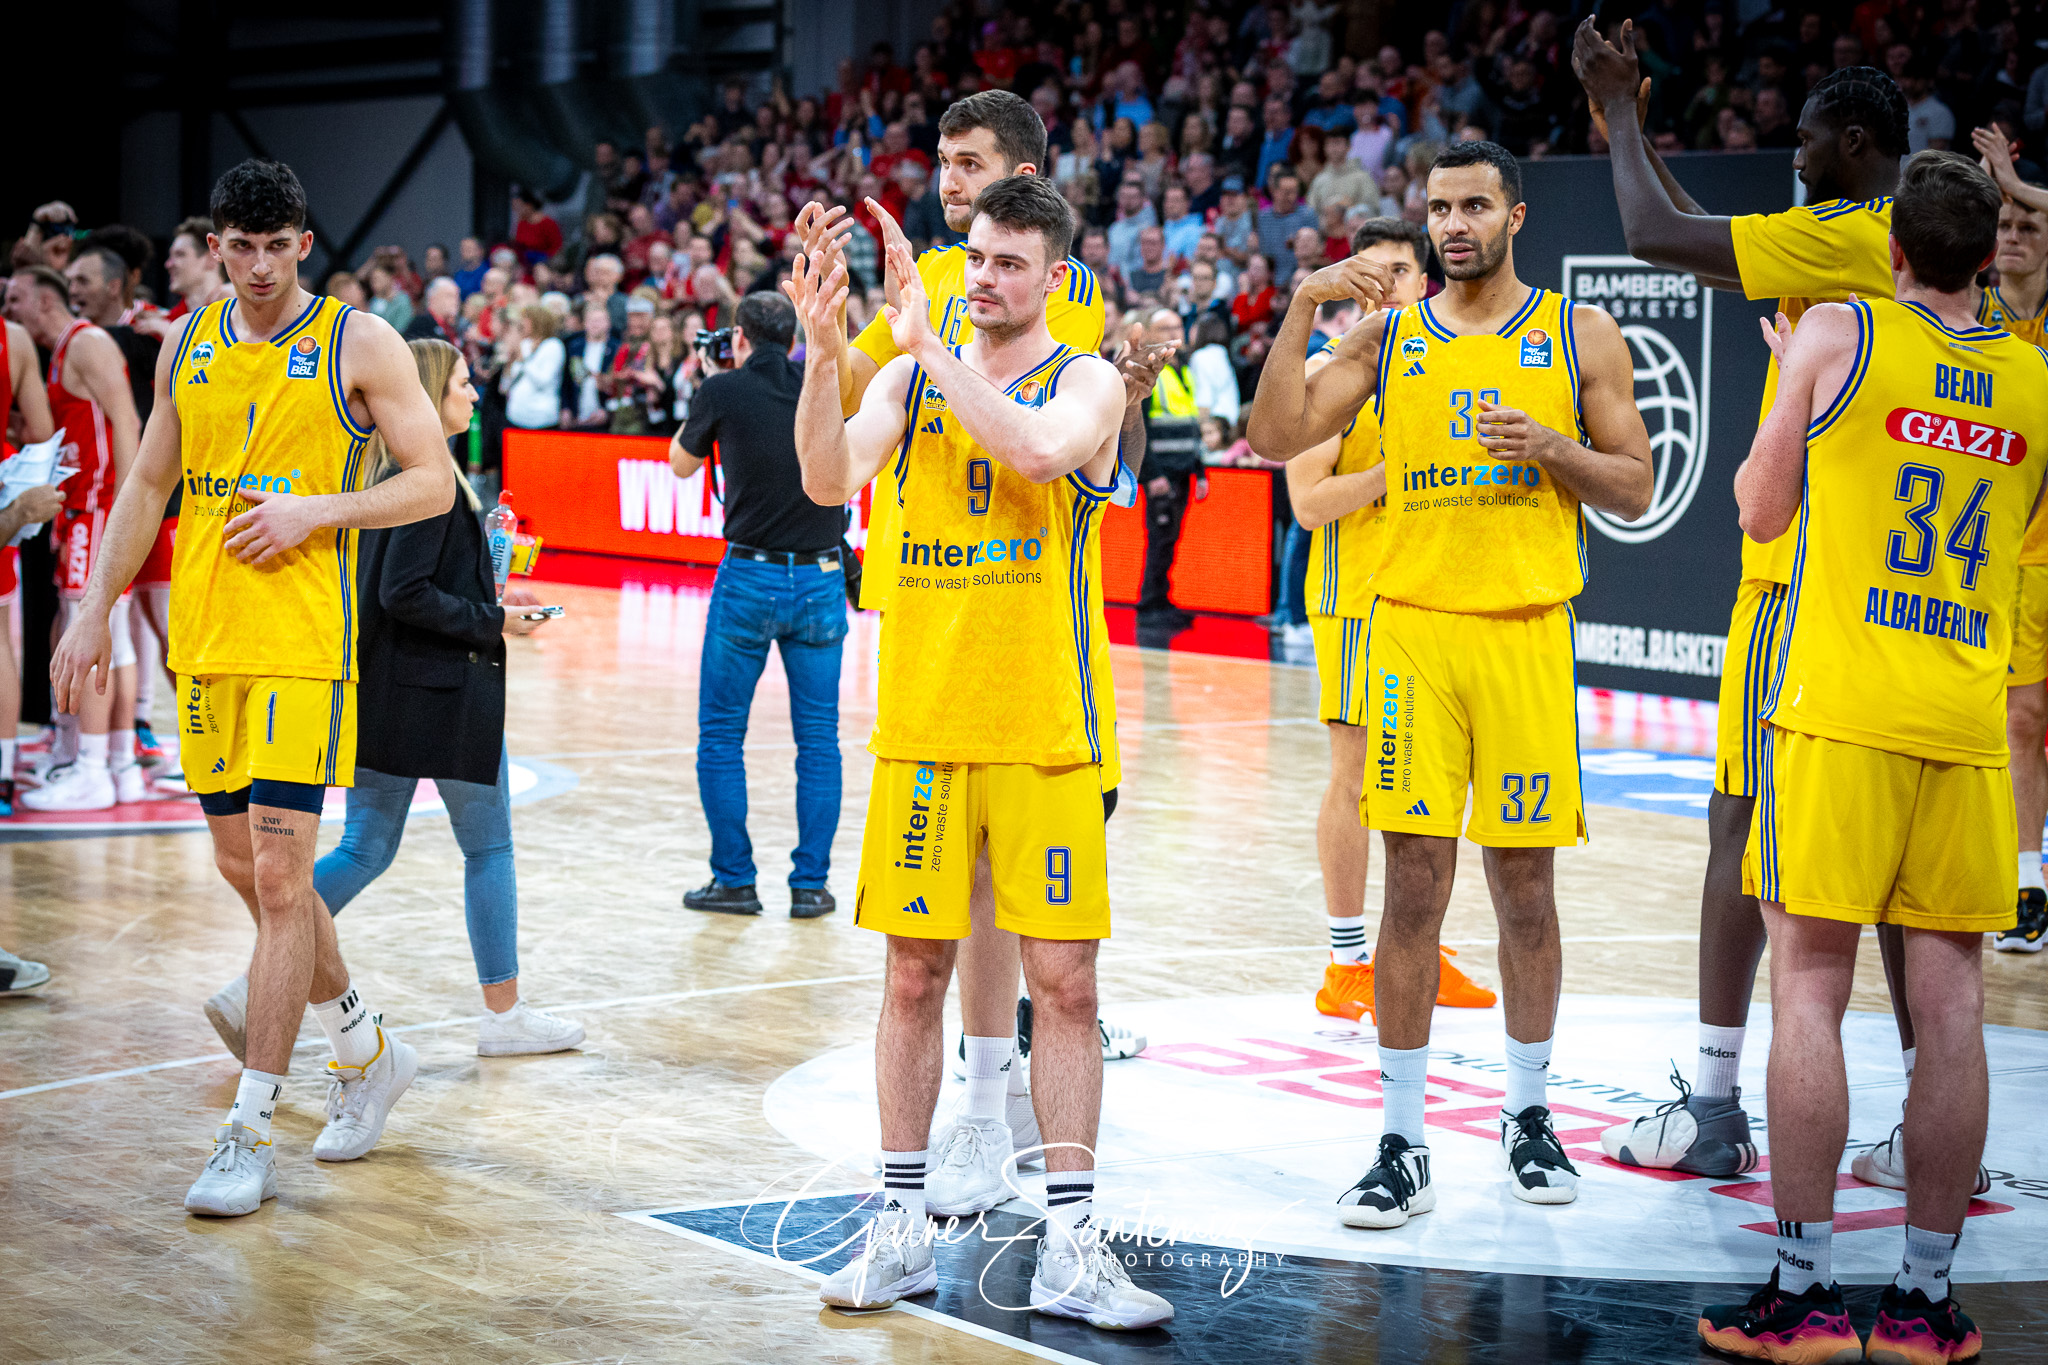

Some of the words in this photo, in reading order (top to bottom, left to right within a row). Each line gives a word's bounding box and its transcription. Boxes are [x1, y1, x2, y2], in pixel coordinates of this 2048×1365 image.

[1576, 273, 1698, 299] BAMBERG
[1578, 300, 1698, 319] SKETS
[290, 365, 314, 376] BBL
[1523, 355, 1548, 365] BBL
[1935, 362, 1993, 408] BEAN
[966, 457, 993, 516] 9
[1404, 462, 1540, 491] interzero
[1403, 500, 1430, 512] zero
[1432, 494, 1473, 507] waste
[1478, 493, 1539, 508] solutions
[1885, 461, 1993, 591] 34
[898, 575, 931, 589] zero
[972, 570, 1042, 586] solutions
[1864, 586, 1922, 633] ALBA
[1923, 596, 1989, 650] BERLIN
[266, 692, 277, 744] 1
[1404, 675, 1415, 728] solutions
[206, 713, 219, 733] zero
[1376, 673, 1399, 791] interzero
[1404, 731, 1413, 765] waste
[1402, 768, 1412, 793] zero
[1500, 772, 1551, 824] 32
[935, 803, 948, 841] waste
[931, 845, 942, 872] zero
[1045, 846, 1071, 905] 9
